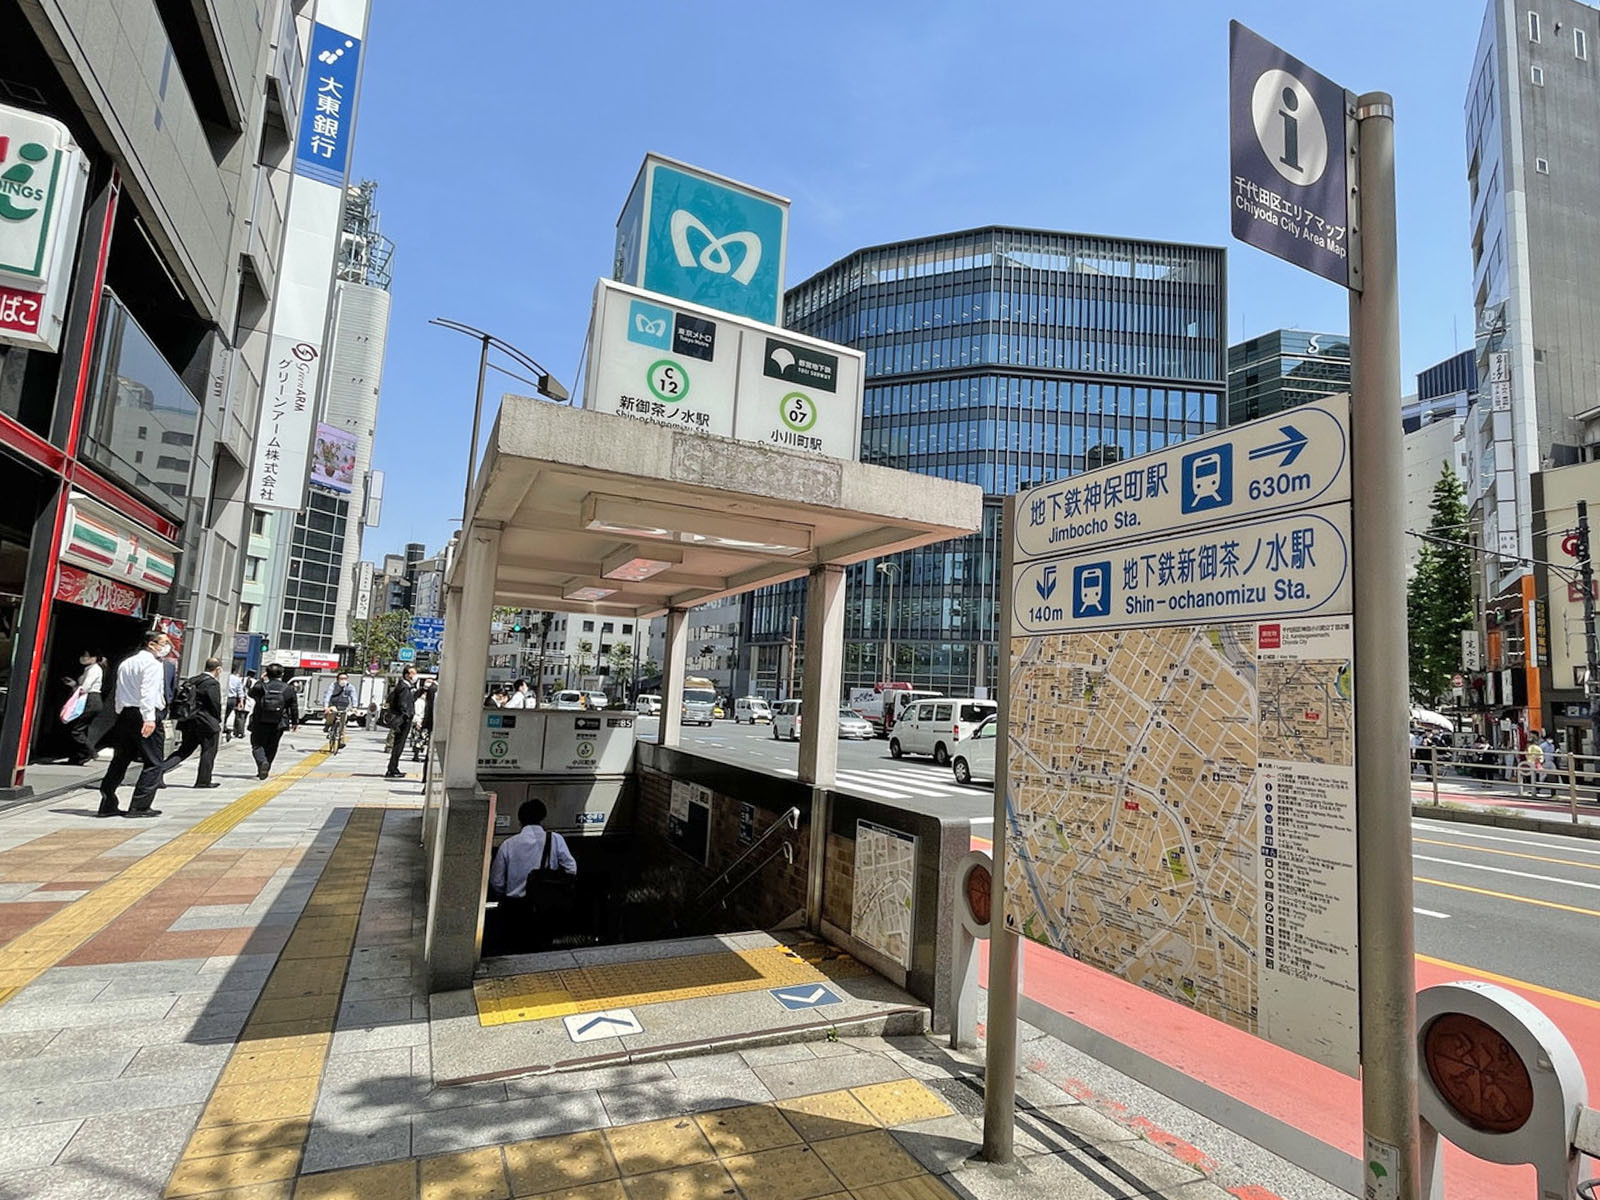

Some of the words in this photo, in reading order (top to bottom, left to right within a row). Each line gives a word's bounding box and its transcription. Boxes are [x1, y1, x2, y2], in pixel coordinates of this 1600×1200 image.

[311, 76, 344, 160] 大東銀行
[0, 180, 44, 201] INGS
[1234, 175, 1347, 241] 千代田区エリアマップ
[1235, 195, 1279, 226] Chiyoda
[1280, 217, 1302, 239] City
[1303, 229, 1325, 248] Area
[1326, 238, 1347, 259] Map
[677, 327, 713, 343] 東京メトロ
[659, 379, 678, 394] 12
[664, 367, 674, 379] C
[619, 395, 710, 427] 新御茶ノ水駅
[789, 410, 807, 423] 07
[795, 398, 803, 410] S
[260, 358, 293, 501] グリーンアーム株式会社
[771, 429, 823, 451] 小川町駅
[1029, 462, 1169, 528] 地下鉄神保町駅
[1249, 472, 1311, 501] 630m
[1048, 517, 1108, 544] Jimbocho
[1114, 510, 1142, 530] Sta.
[1122, 527, 1316, 591] 地下鉄新御茶ノ水駅
[1125, 583, 1266, 616] Shin-ochanomizu
[1274, 579, 1312, 602] Sta.
[1029, 606, 1063, 623] 140m
